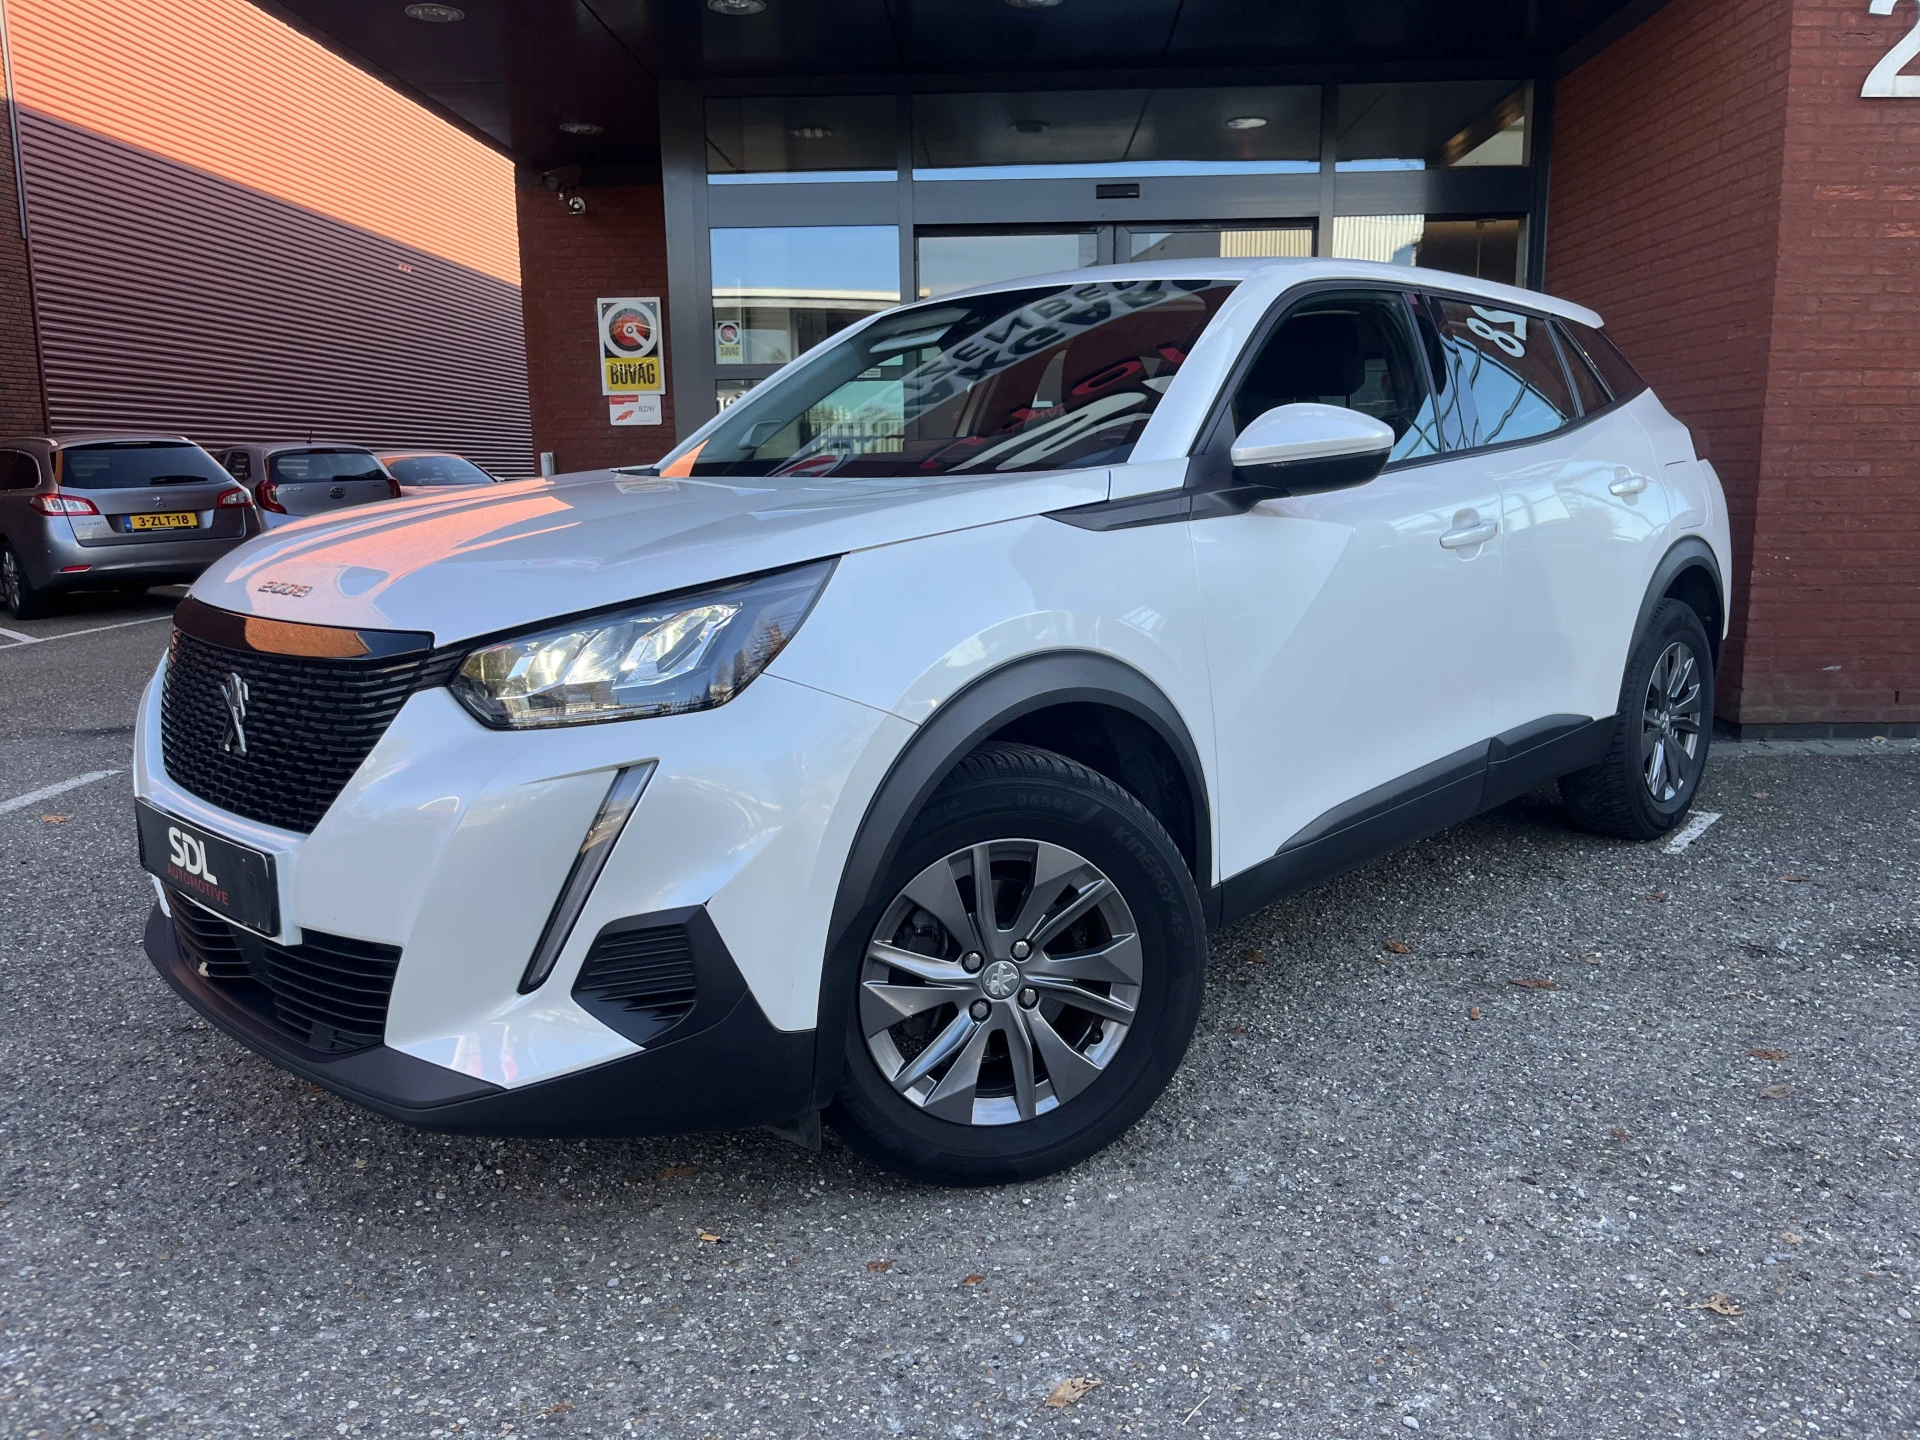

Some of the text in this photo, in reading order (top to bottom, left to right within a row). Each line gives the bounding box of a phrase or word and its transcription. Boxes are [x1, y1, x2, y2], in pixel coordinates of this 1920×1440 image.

[610, 362, 656, 385] BOVAG
[638, 405, 656, 413] RDW
[138, 514, 190, 527] 3-ZLT-18
[257, 581, 313, 598] 2008
[168, 826, 218, 886] SDL
[1111, 825, 1180, 905] KINERGY
[167, 862, 230, 906] AUTOMOTIVE
